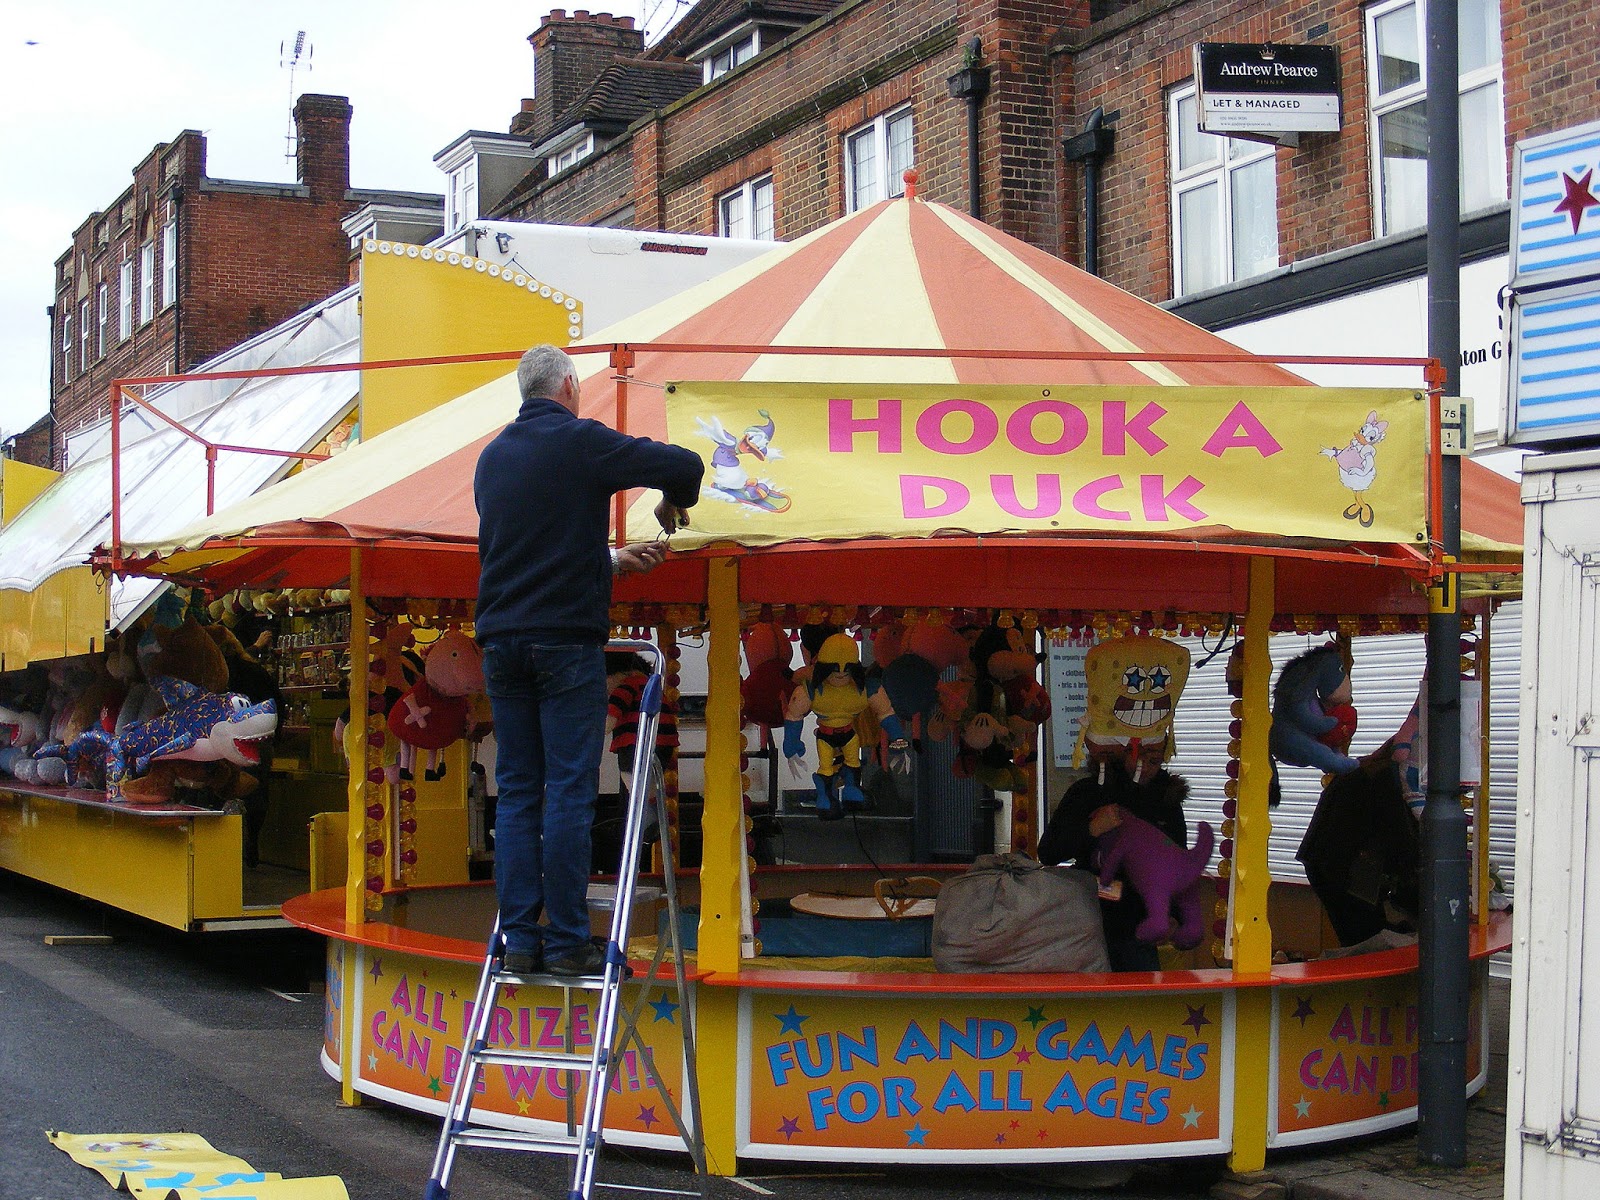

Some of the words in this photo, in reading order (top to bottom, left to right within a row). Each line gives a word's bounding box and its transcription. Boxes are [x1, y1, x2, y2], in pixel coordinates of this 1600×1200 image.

[1220, 62, 1272, 76] Andrew
[1273, 63, 1318, 77] Pearce
[1213, 99, 1232, 107] LET
[1235, 99, 1242, 107] &
[1246, 100, 1300, 109] MANAGED
[829, 399, 1168, 457] HOOK
[1201, 400, 1283, 458] A
[1444, 409, 1457, 419] 75
[899, 473, 1209, 522] DUCK
[391, 972, 448, 1034] ALL
[1329, 1002, 1394, 1047] ALL
[371, 1010, 431, 1076] CAN
[766, 1025, 880, 1087] FUN
[894, 1016, 1019, 1064] AND
[1034, 1018, 1209, 1081] GAMES
[1299, 1048, 1380, 1096] CAN
[807, 1075, 924, 1131] FOR
[932, 1069, 1032, 1114] ALL
[1044, 1070, 1172, 1127] AGES
